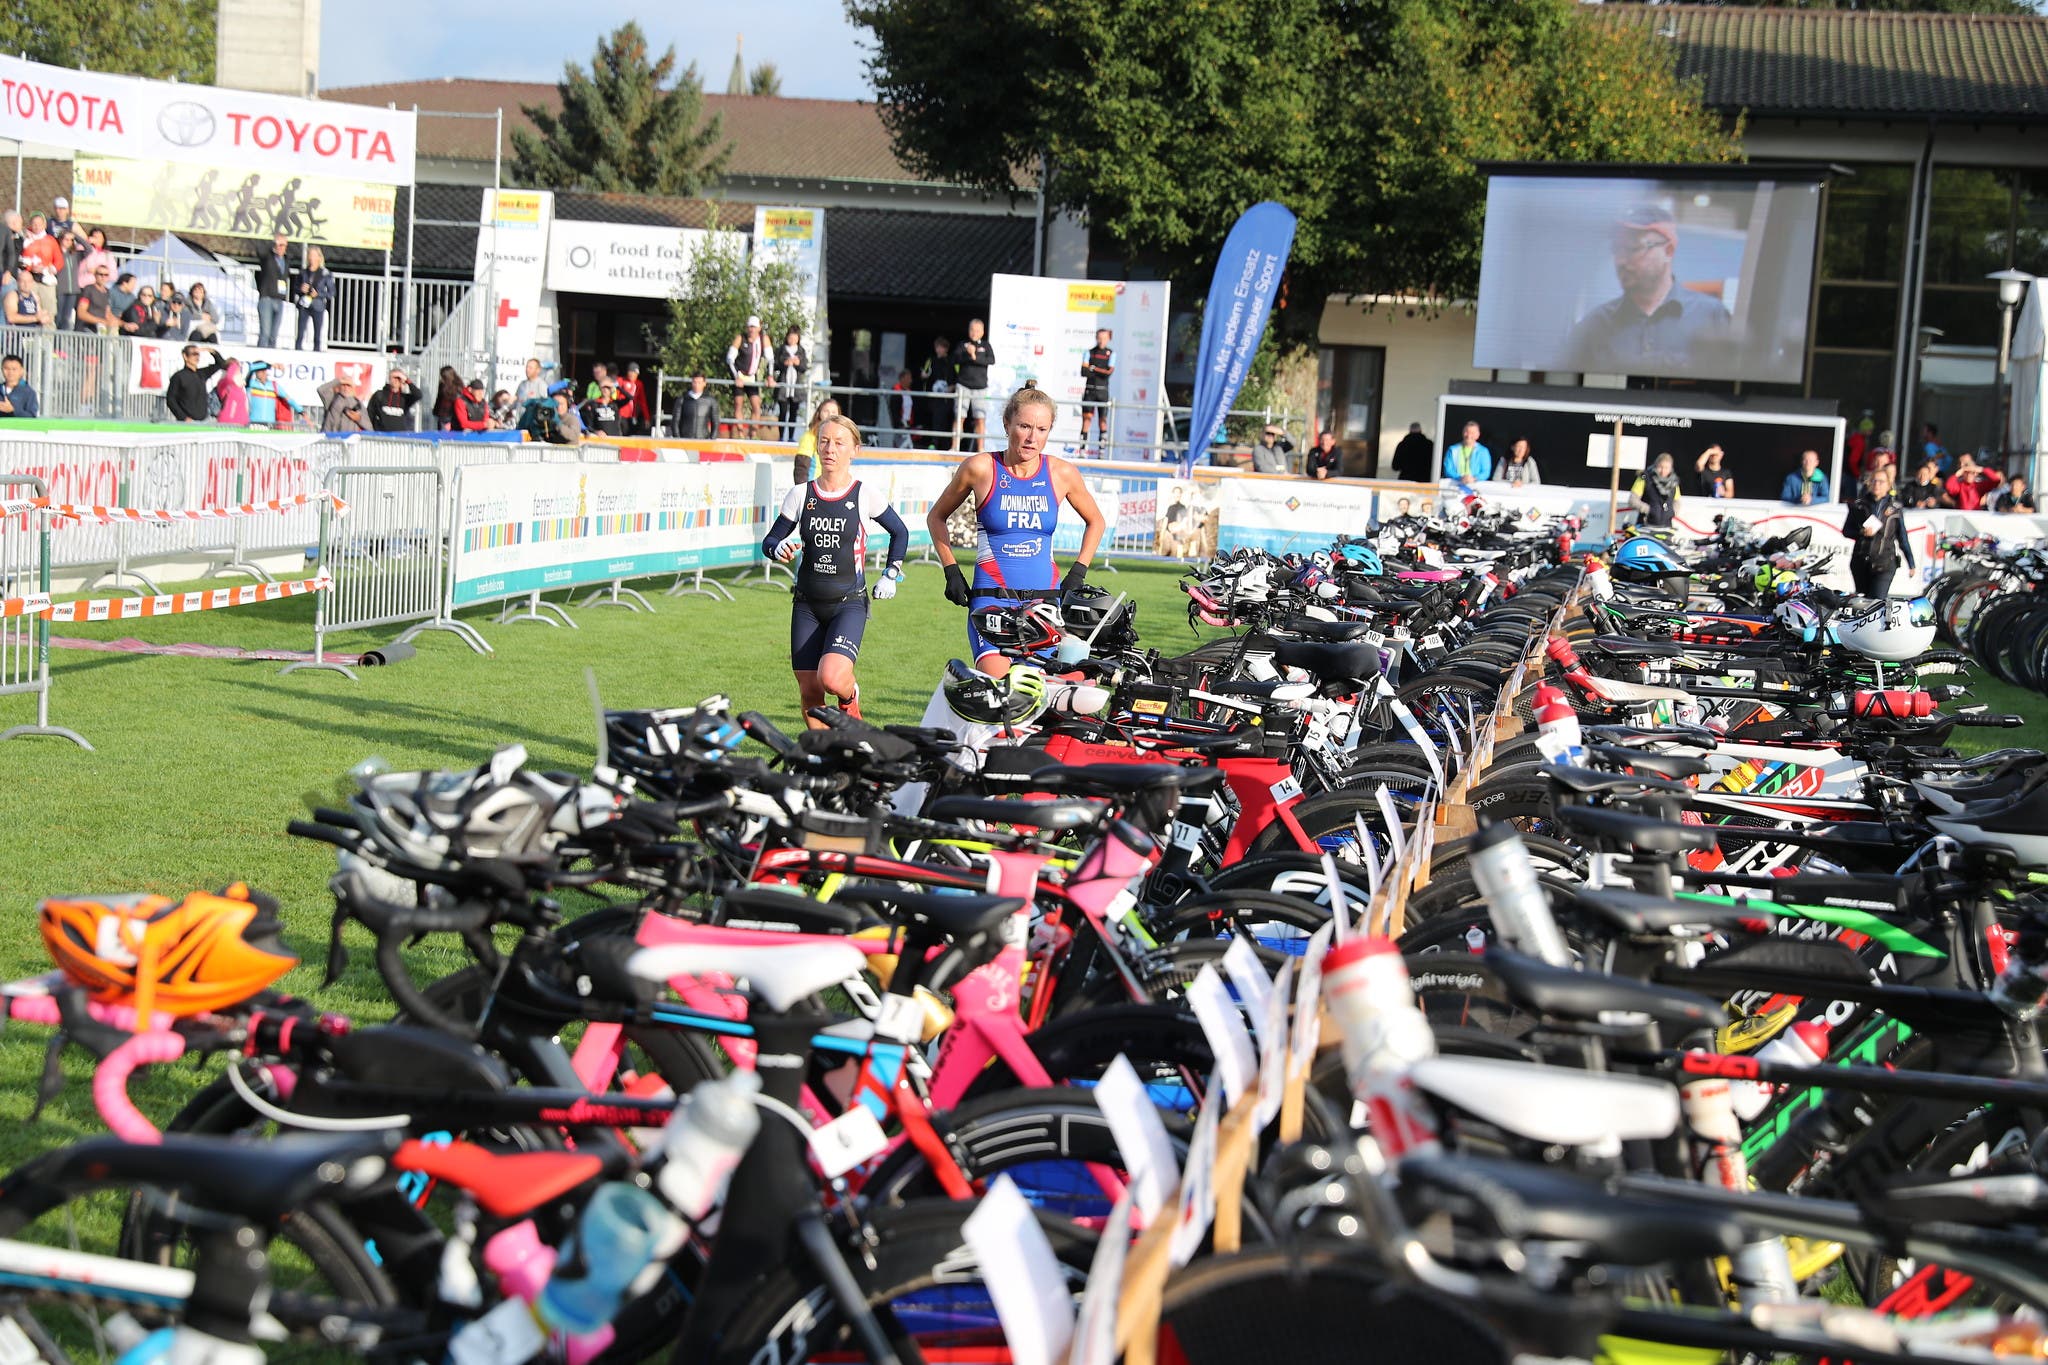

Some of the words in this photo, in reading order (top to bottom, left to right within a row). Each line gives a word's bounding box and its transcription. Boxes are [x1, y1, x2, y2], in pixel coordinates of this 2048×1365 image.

[2, 79, 124, 135] TOYOTA
[226, 112, 396, 163] TOYOTA
[85, 167, 113, 186] MAN
[353, 195, 392, 214] POWER
[483, 251, 539, 264] Massage
[609, 241, 648, 258] food
[1234, 248, 1261, 299] Einsatz
[1254, 253, 1279, 294] Sport
[1221, 301, 1245, 347] jedem
[1235, 296, 1265, 359] Aargauer
[1214, 348, 1231, 375] Mit
[1228, 360, 1243, 386] der
[1000, 494, 1050, 513] MONMARTEAU
[808, 516, 848, 533] POOLEY
[1007, 511, 1043, 530] FRA
[814, 533, 842, 549] GBR
[1004, 543, 1031, 551] Running
[813, 562, 838, 571] BRITISH
[988, 613, 999, 629] 15
[1891, 615, 1902, 627] 16
[1367, 631, 1382, 644] 102
[1633, 715, 1645, 728] 14
[1307, 728, 1321, 742] 15
[1278, 779, 1293, 795] 14
[1472, 791, 1506, 811] aeolus
[1177, 824, 1190, 842] 11
[1409, 971, 1484, 992] ightweight
